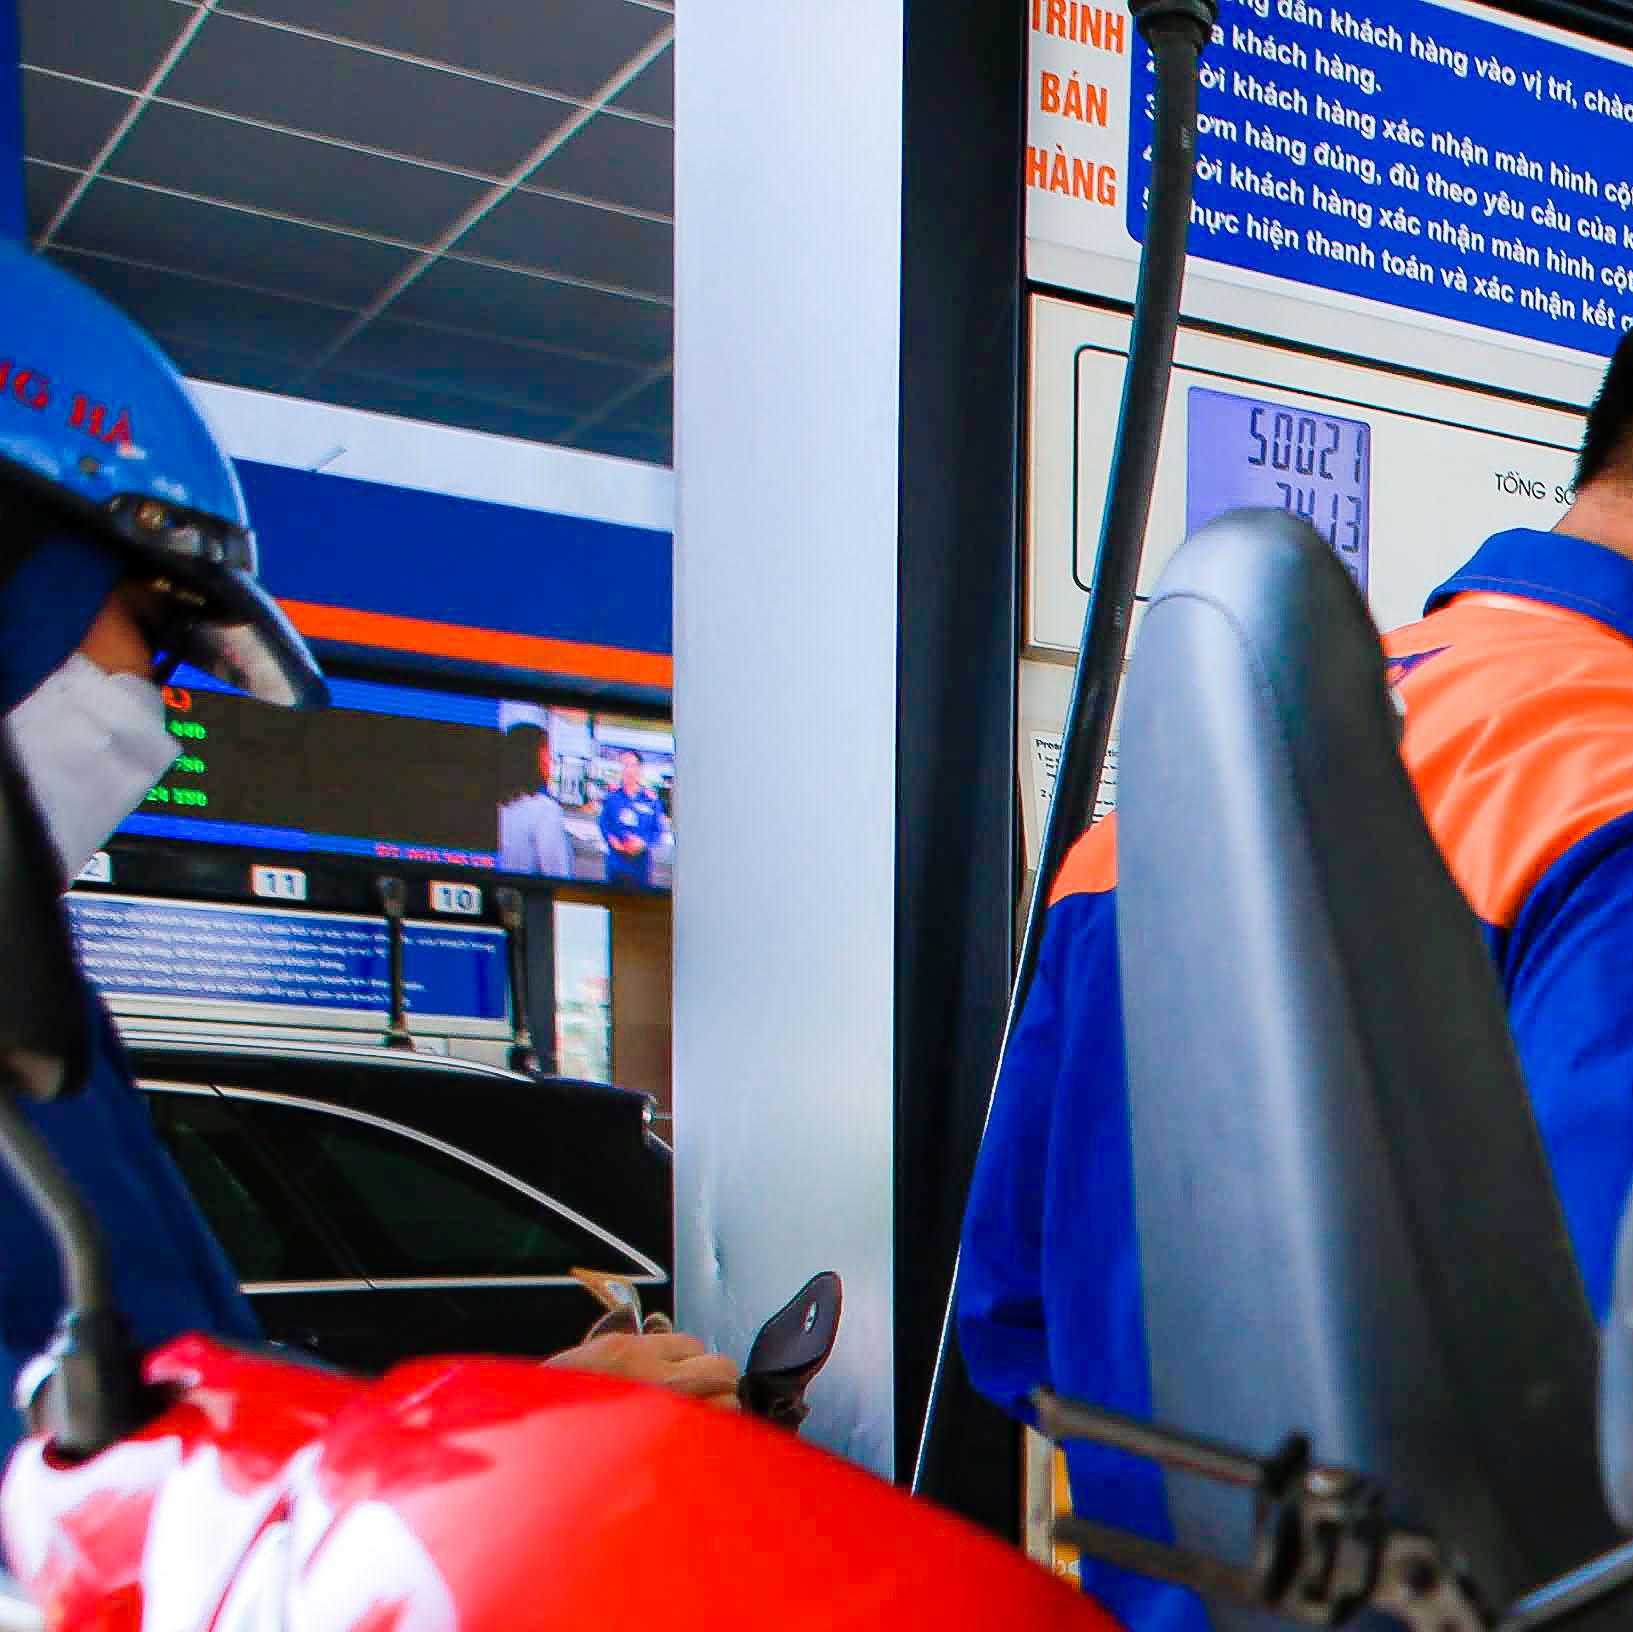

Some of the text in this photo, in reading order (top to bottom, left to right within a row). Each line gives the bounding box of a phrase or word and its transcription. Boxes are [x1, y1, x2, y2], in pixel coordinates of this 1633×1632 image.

[1232, 24, 1307, 70] khách
[1315, 48, 1382, 95] hàng.
[1330, 7, 1403, 53] khách
[1409, 31, 1469, 78] hàng
[1474, 55, 1517, 86] vào
[1041, 71, 1108, 128] BÁN
[1199, 61, 1226, 93] ời
[1233, 71, 1308, 116] khách
[1315, 94, 1376, 140] hàng
[1382, 118, 1425, 148] xác
[1431, 131, 1489, 167] nhận
[1495, 151, 1543, 183] màn
[1025, 144, 1116, 207] HÀNG
[1195, 153, 1223, 185] ời
[1230, 162, 1305, 206] khách
[1312, 184, 1373, 229] hàng
[1379, 206, 1421, 235] xác
[1427, 218, 1485, 255] nhận
[1491, 237, 1540, 268] màn
[1196, 113, 1237, 142] ơm
[1245, 120, 1307, 166] hàng
[1425, 171, 1478, 206] theo
[1483, 190, 1525, 220] yêu
[1530, 198, 1571, 233] cầu
[1577, 215, 1617, 245] của
[1189, 198, 1239, 235] hực
[1246, 212, 1299, 251] hiện
[1306, 230, 1375, 269] thanh
[1381, 249, 1434, 284] toán
[1439, 266, 1468, 293] và
[1473, 275, 1515, 303] xác
[1520, 286, 1576, 321] nhận
[1247, 407, 1363, 484] 50021
[1495, 471, 1546, 500] TỔNG
[266, 873, 296, 895] 11
[442, 889, 473, 910] 10
